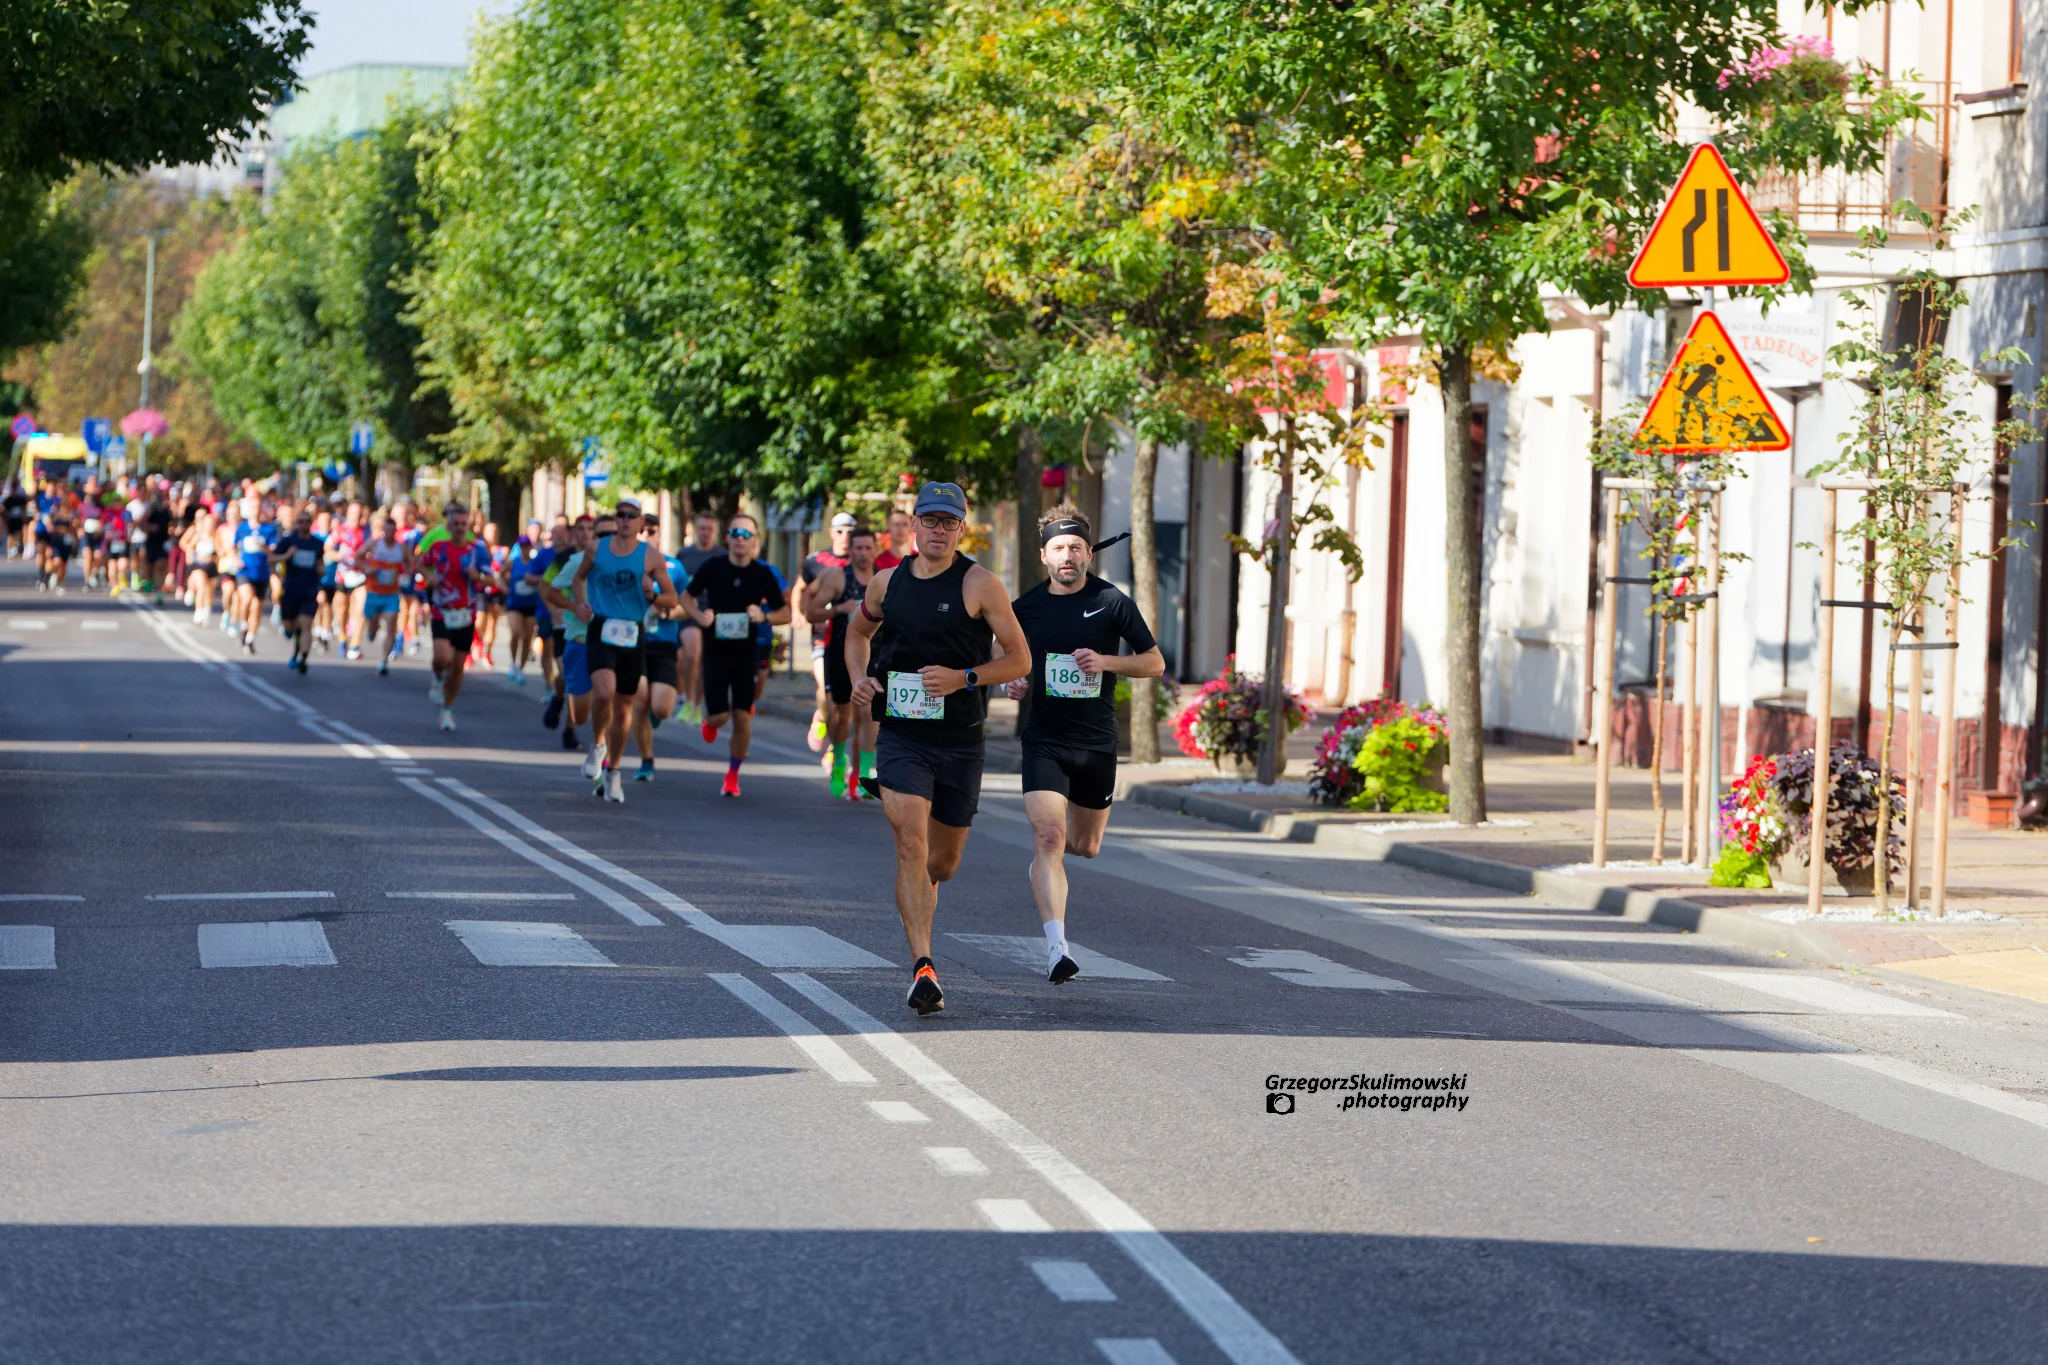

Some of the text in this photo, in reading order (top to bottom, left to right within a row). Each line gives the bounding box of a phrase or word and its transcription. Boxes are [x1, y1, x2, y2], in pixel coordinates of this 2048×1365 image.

[1740, 335, 1819, 368] TADEUSZ
[1050, 668, 1080, 684] 186
[892, 687, 919, 703] 197
